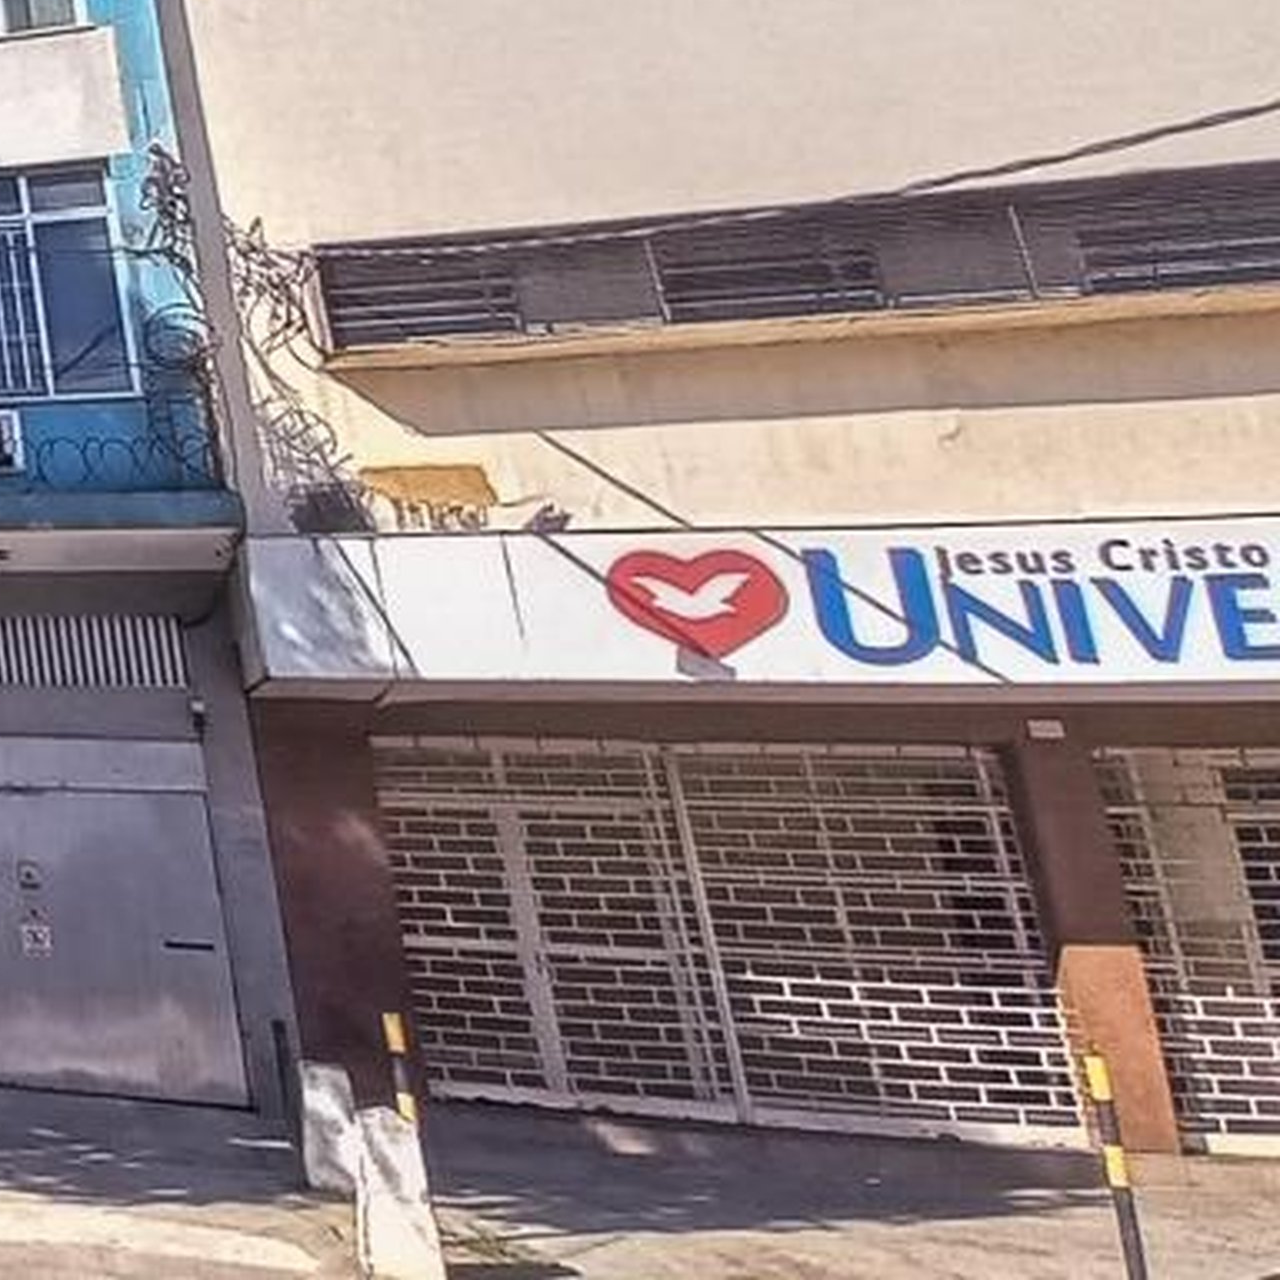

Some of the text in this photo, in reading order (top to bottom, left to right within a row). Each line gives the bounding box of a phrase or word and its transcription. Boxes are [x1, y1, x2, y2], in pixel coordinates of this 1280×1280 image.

[934, 538, 1271, 580] Jesus Cristo
[800, 547, 1280, 666] UNIVE
